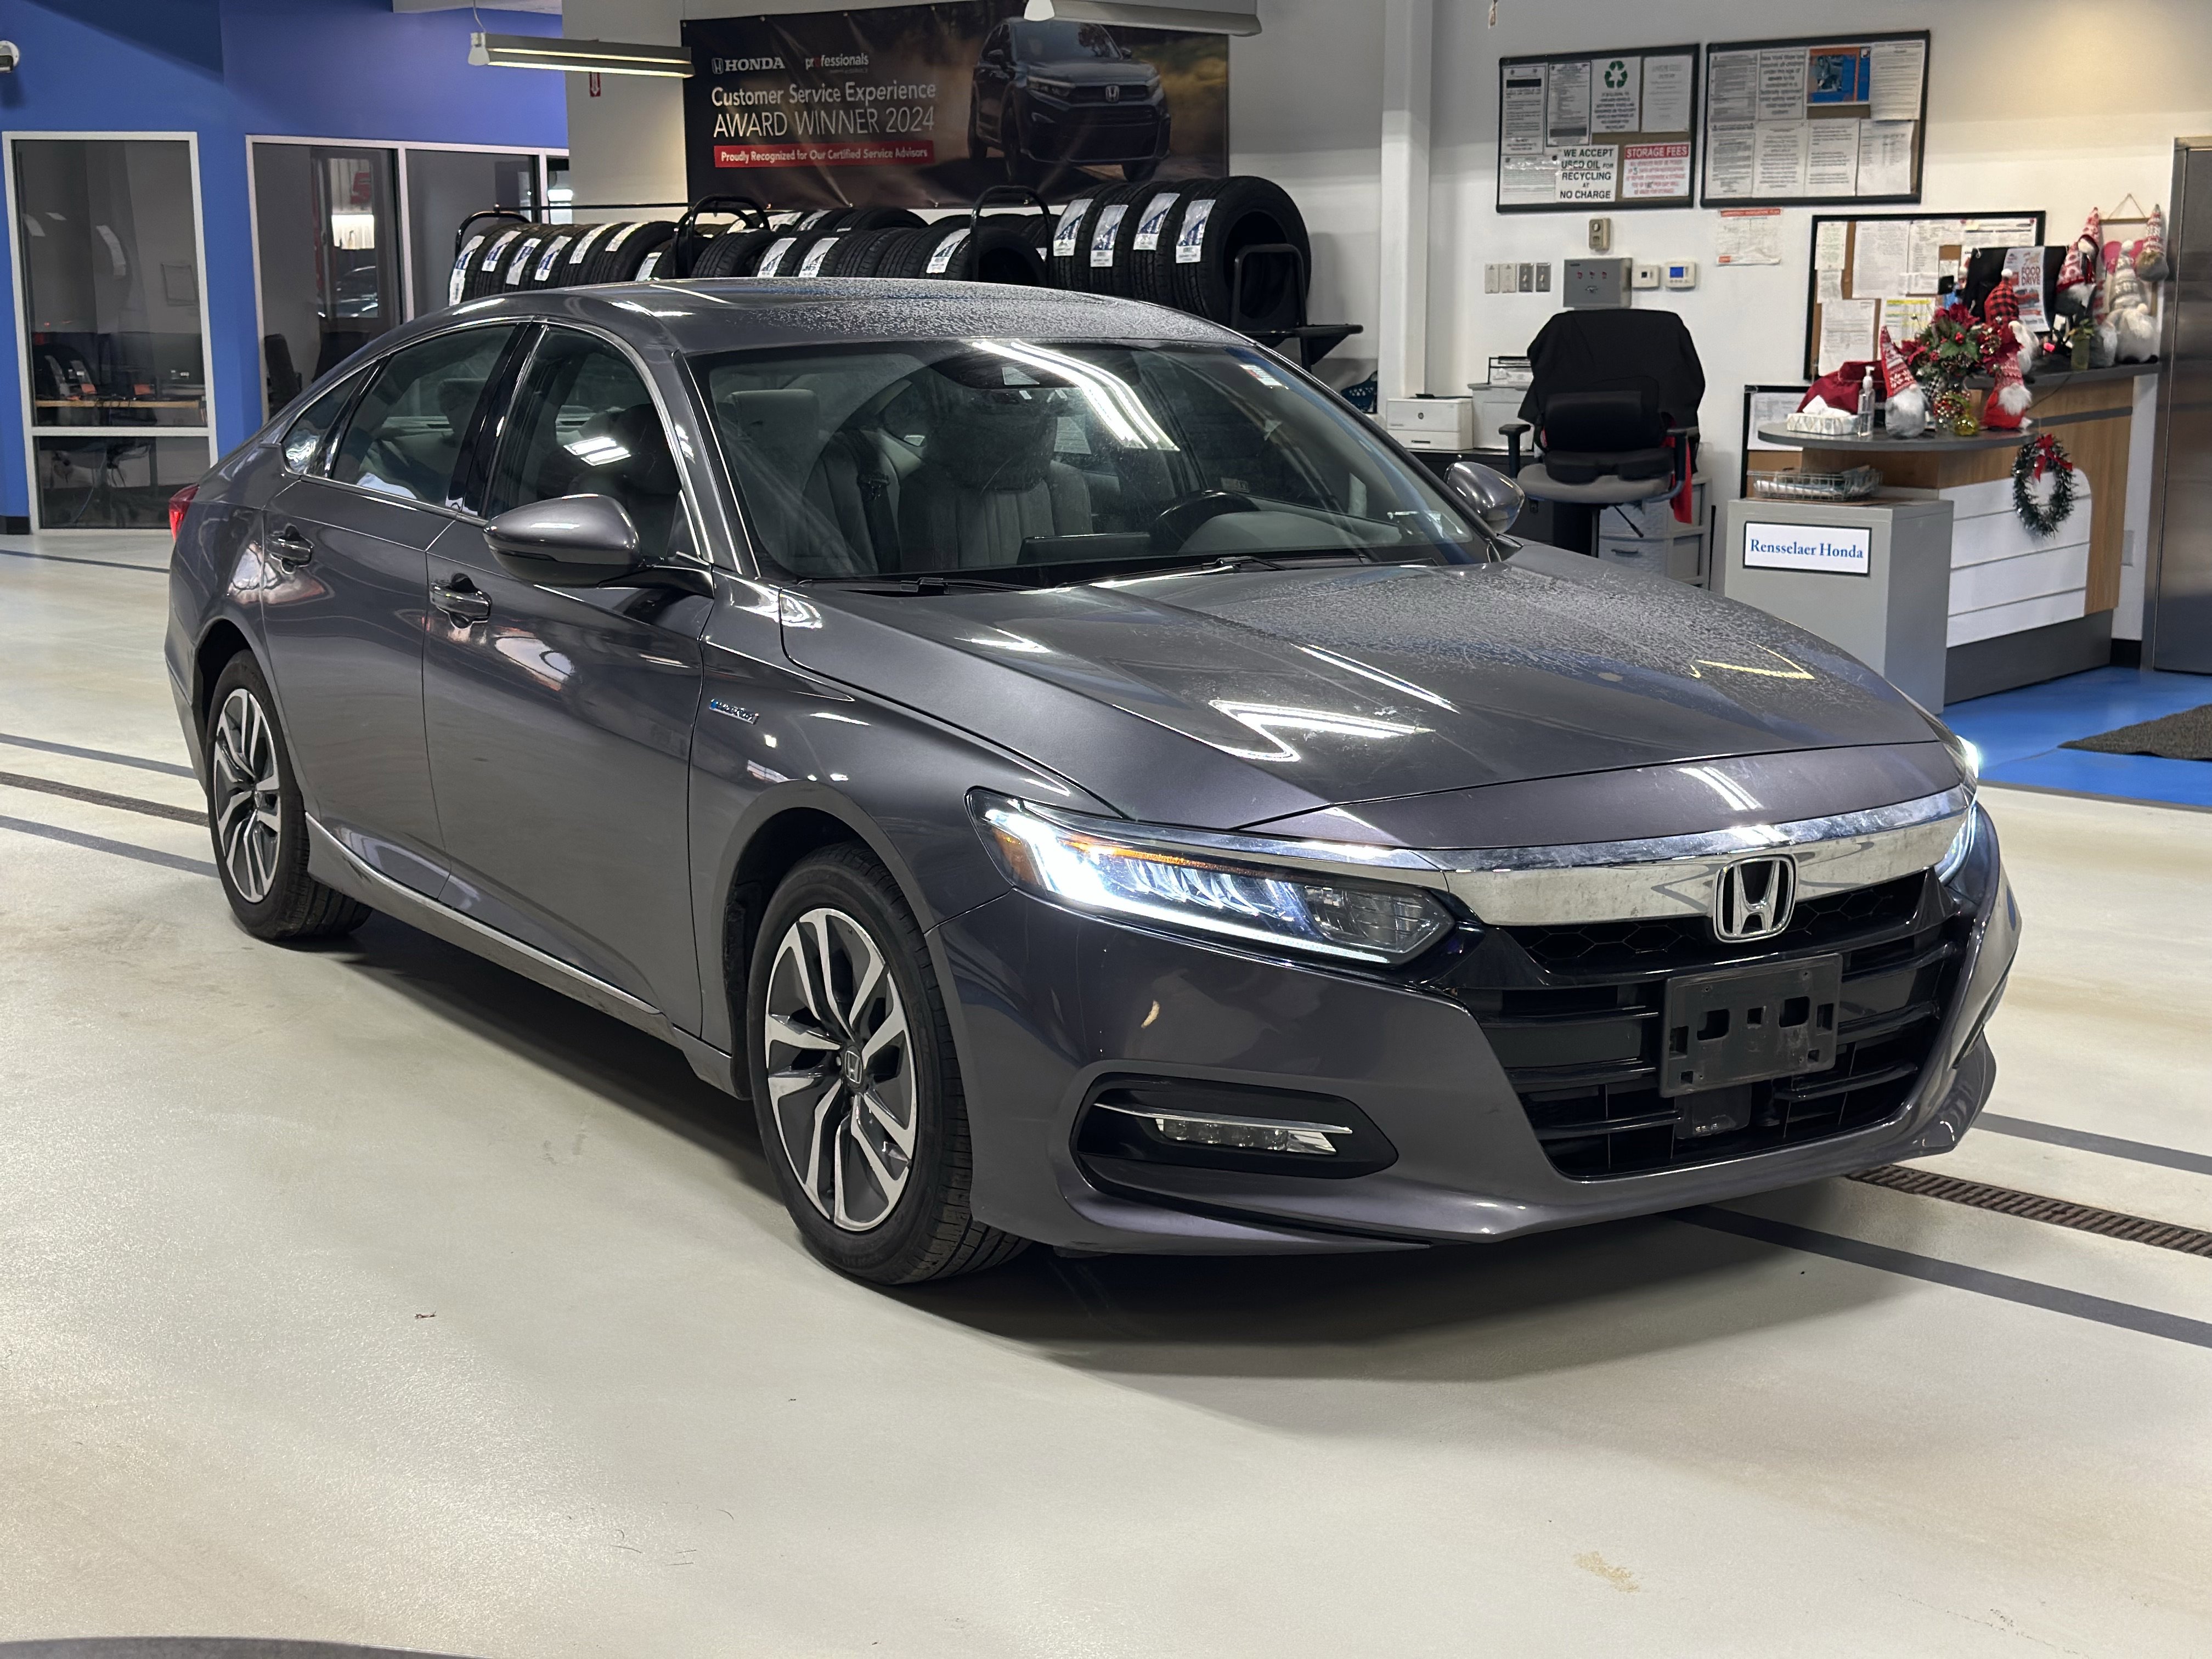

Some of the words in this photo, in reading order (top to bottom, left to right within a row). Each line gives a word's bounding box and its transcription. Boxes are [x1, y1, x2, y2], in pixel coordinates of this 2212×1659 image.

[725, 57, 786, 72] HONDA
[805, 53, 869, 70] professionals
[712, 86, 784, 106] Customer
[789, 83, 841, 104] Service
[845, 79, 936, 106] Experience
[714, 111, 787, 138] AWARD
[795, 108, 879, 135] WINNER
[885, 105, 935, 133] 2024
[721, 150, 749, 164] Proudly
[751, 149, 795, 163] Recognized
[797, 149, 808, 160] for
[809, 150, 825, 160] Our
[827, 148, 860, 160] Certified
[863, 148, 893, 159] Service
[895, 146, 928, 158] Advisors
[1564, 149, 1576, 157] WE
[1579, 148, 1613, 157] ACCEPT
[1626, 148, 1664, 159] STORAGE
[1666, 146, 1687, 156] FEES
[1561, 161, 1584, 170] USED
[1587, 160, 1600, 169] OIL
[1562, 171, 1611, 180] RECYCLING
[1560, 190, 1574, 199] NO
[1577, 190, 1611, 199] CHARGE
[2021, 266, 2041, 275] FOOD
[2021, 276, 2041, 286] DRIVE
[1750, 538, 1817, 556] Rensselaer
[1819, 543, 1864, 558] Honda
